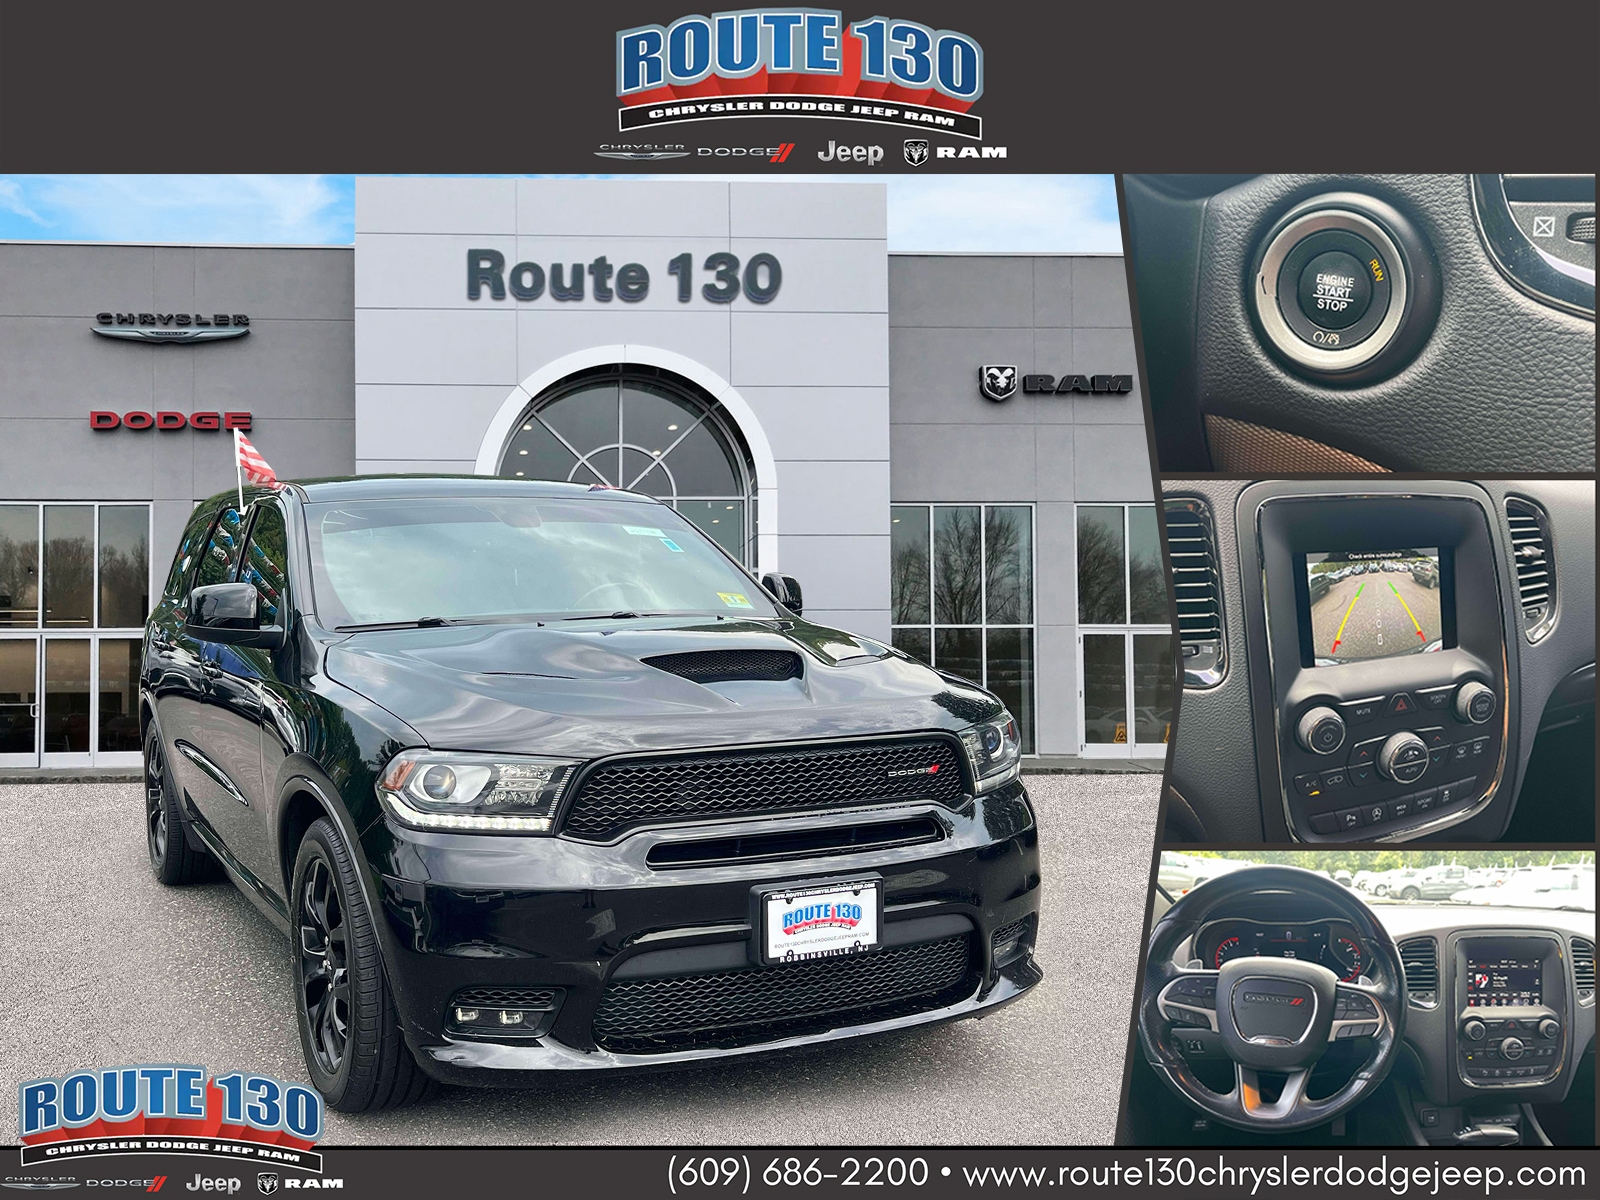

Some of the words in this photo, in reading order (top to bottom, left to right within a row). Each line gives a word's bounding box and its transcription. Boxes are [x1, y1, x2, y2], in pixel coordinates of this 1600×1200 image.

[467, 248, 650, 301] Route
[668, 252, 782, 304] 130
[1316, 273, 1355, 287] ENGINE
[1369, 259, 1384, 282] RUN
[1316, 285, 1351, 298] START
[1317, 299, 1347, 312] STOP
[96, 312, 250, 326] CHRYSLER
[1023, 374, 1133, 394] RAM
[89, 411, 252, 432] DODGE
[782, 902, 832, 928] ROUTE
[834, 903, 862, 921] 130
[779, 946, 854, 964] ROBBINSVILLE,
